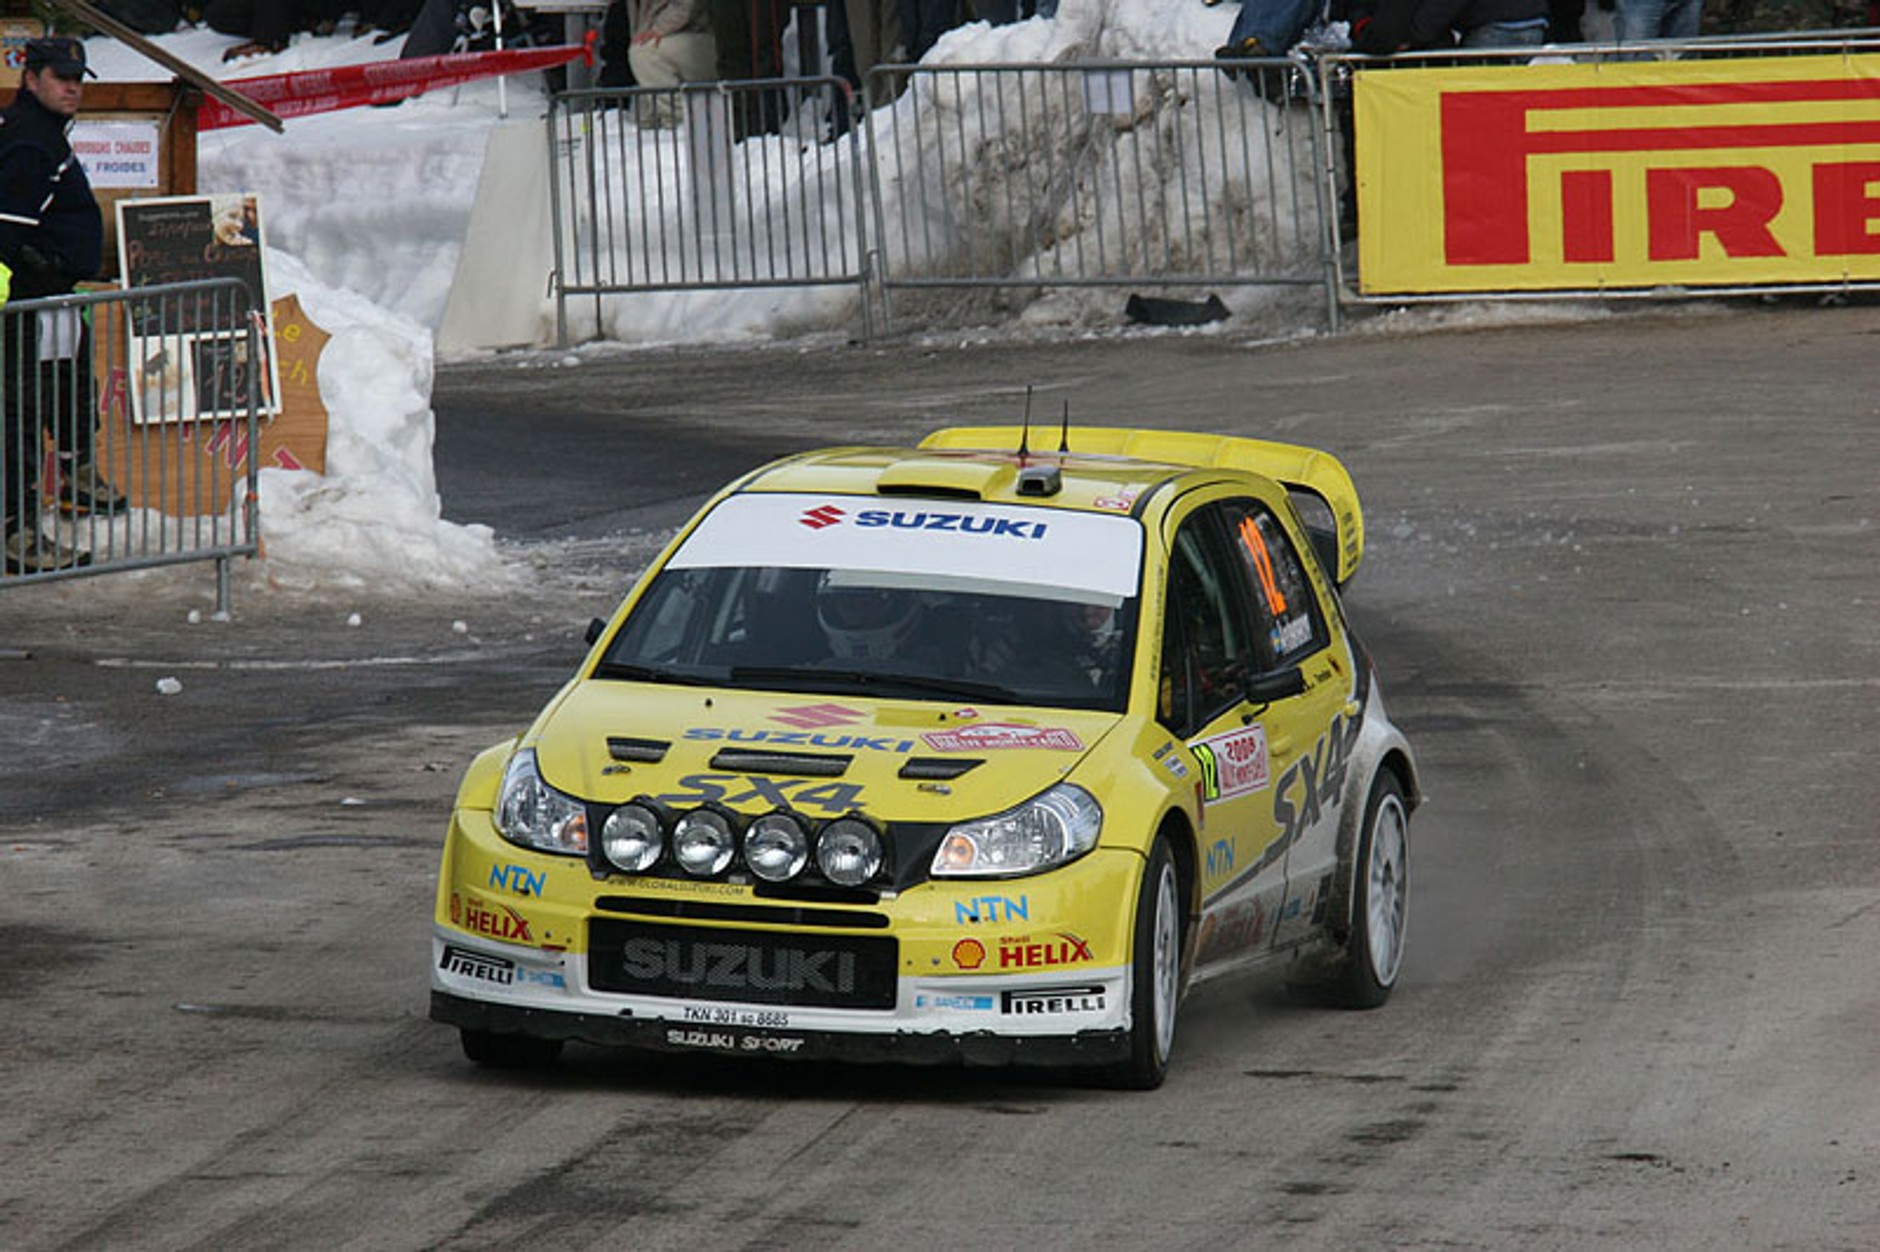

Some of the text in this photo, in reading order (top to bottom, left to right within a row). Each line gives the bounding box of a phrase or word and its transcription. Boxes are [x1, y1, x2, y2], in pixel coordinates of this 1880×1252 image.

[97, 161, 147, 173] FROIDES
[854, 510, 1047, 540] SUZUKI
[682, 728, 915, 753] SUZUKI
[1191, 743, 1219, 800] 12
[1268, 712, 1356, 852] SX4
[657, 775, 867, 812] SX4
[1207, 836, 1236, 878] NTN
[489, 864, 546, 898] NTN
[465, 902, 534, 942] HELIX
[954, 895, 1029, 925] NTN
[999, 935, 1031, 945] Shell
[999, 933, 1094, 968] HELIX
[440, 944, 515, 985] PIRELLI
[622, 937, 856, 994] SUZUKI
[684, 1007, 711, 1021] TKN
[1001, 984, 1107, 1014] PIRELLI
[667, 1029, 805, 1052] SUZUKI SPORT
